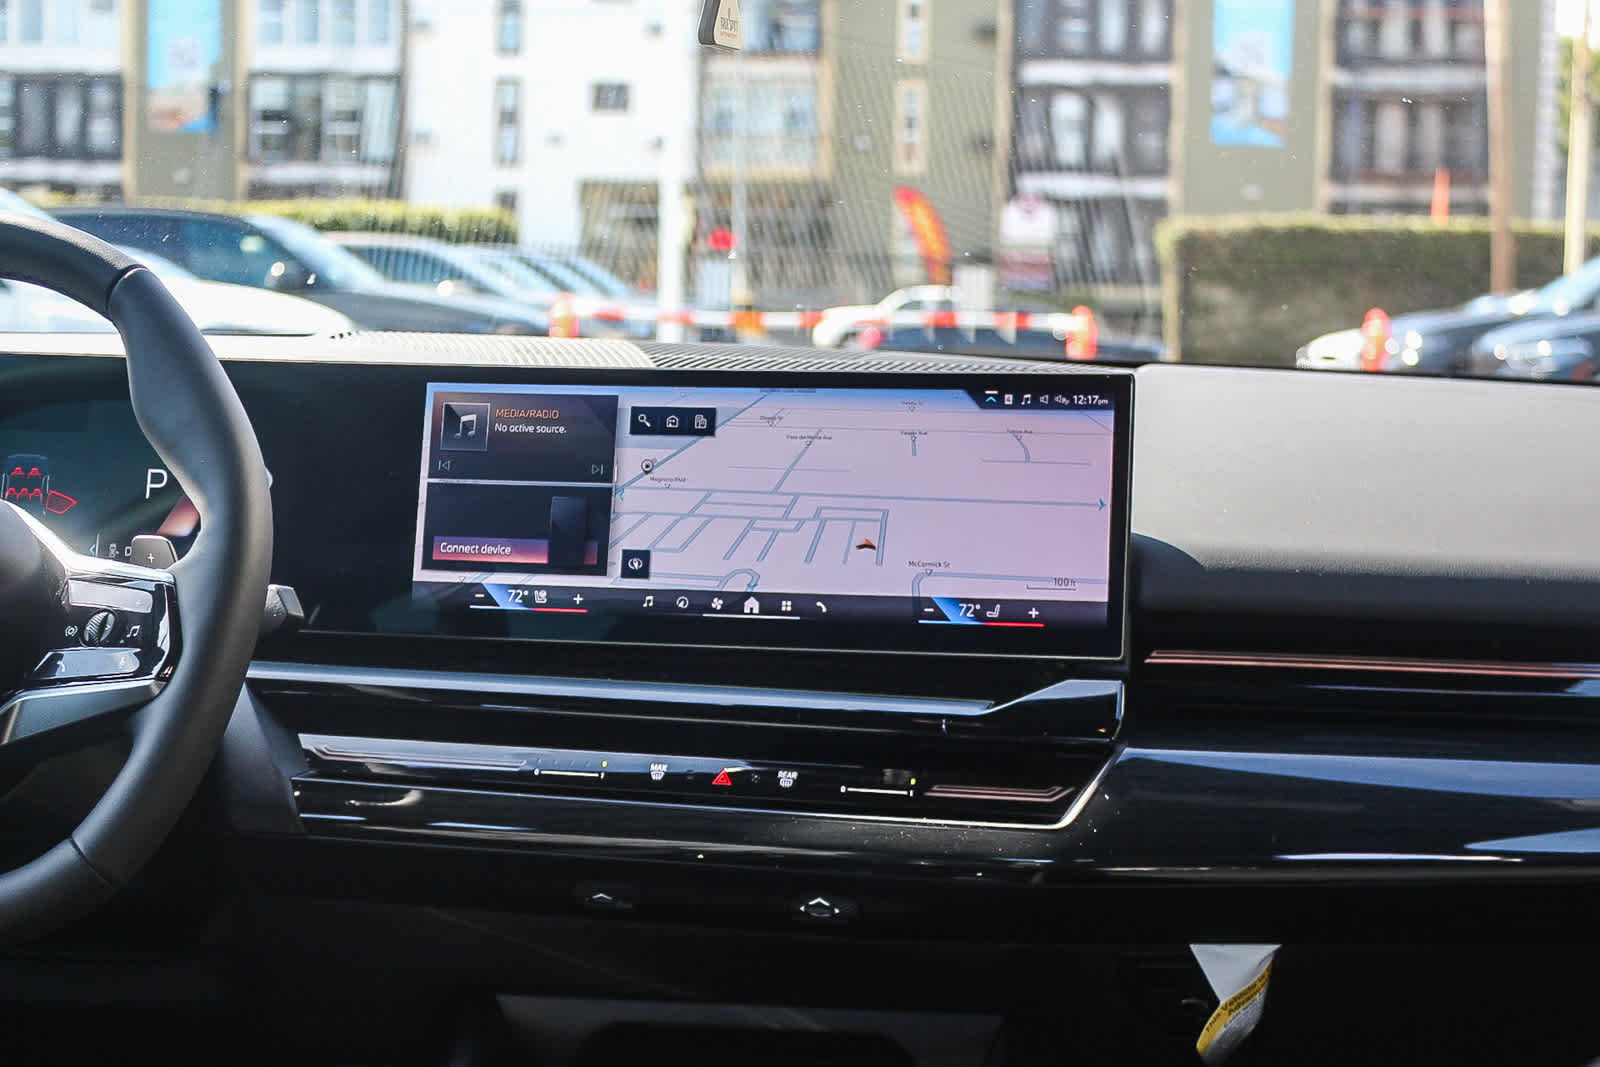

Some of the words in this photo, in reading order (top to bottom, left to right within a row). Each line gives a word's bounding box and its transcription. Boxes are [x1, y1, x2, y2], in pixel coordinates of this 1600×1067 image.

[496, 408, 560, 420] MEDIA/RADIO
[494, 423, 508, 433] No
[510, 423, 534, 434] active
[536, 425, 567, 434] source.
[145, 468, 168, 499] P
[440, 542, 479, 554] Connect
[481, 543, 512, 555] device
[1053, 577, 1069, 587] 100
[1070, 578, 1077, 587] ft
[507, 589, 529, 604] 72°
[958, 603, 981, 618] 72°
[650, 763, 668, 772] MAX
[777, 770, 798, 780] REAR
